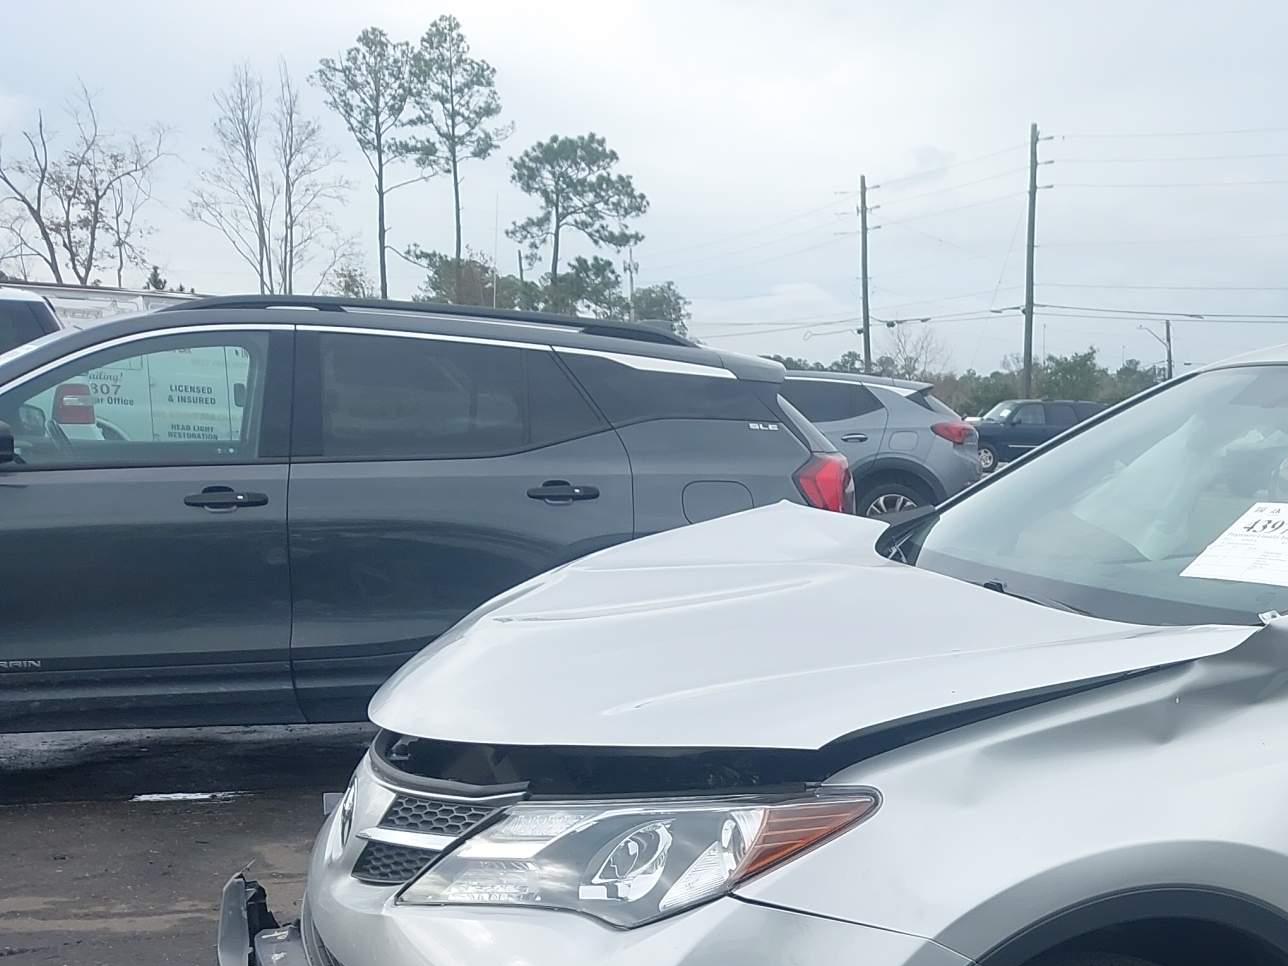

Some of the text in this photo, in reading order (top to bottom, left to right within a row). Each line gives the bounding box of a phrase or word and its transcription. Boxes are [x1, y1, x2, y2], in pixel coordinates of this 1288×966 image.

[169, 384, 213, 394] LICENSED
[106, 396, 134, 406] Office
[167, 395, 217, 405] & INSURED
[748, 422, 780, 430] SLE
